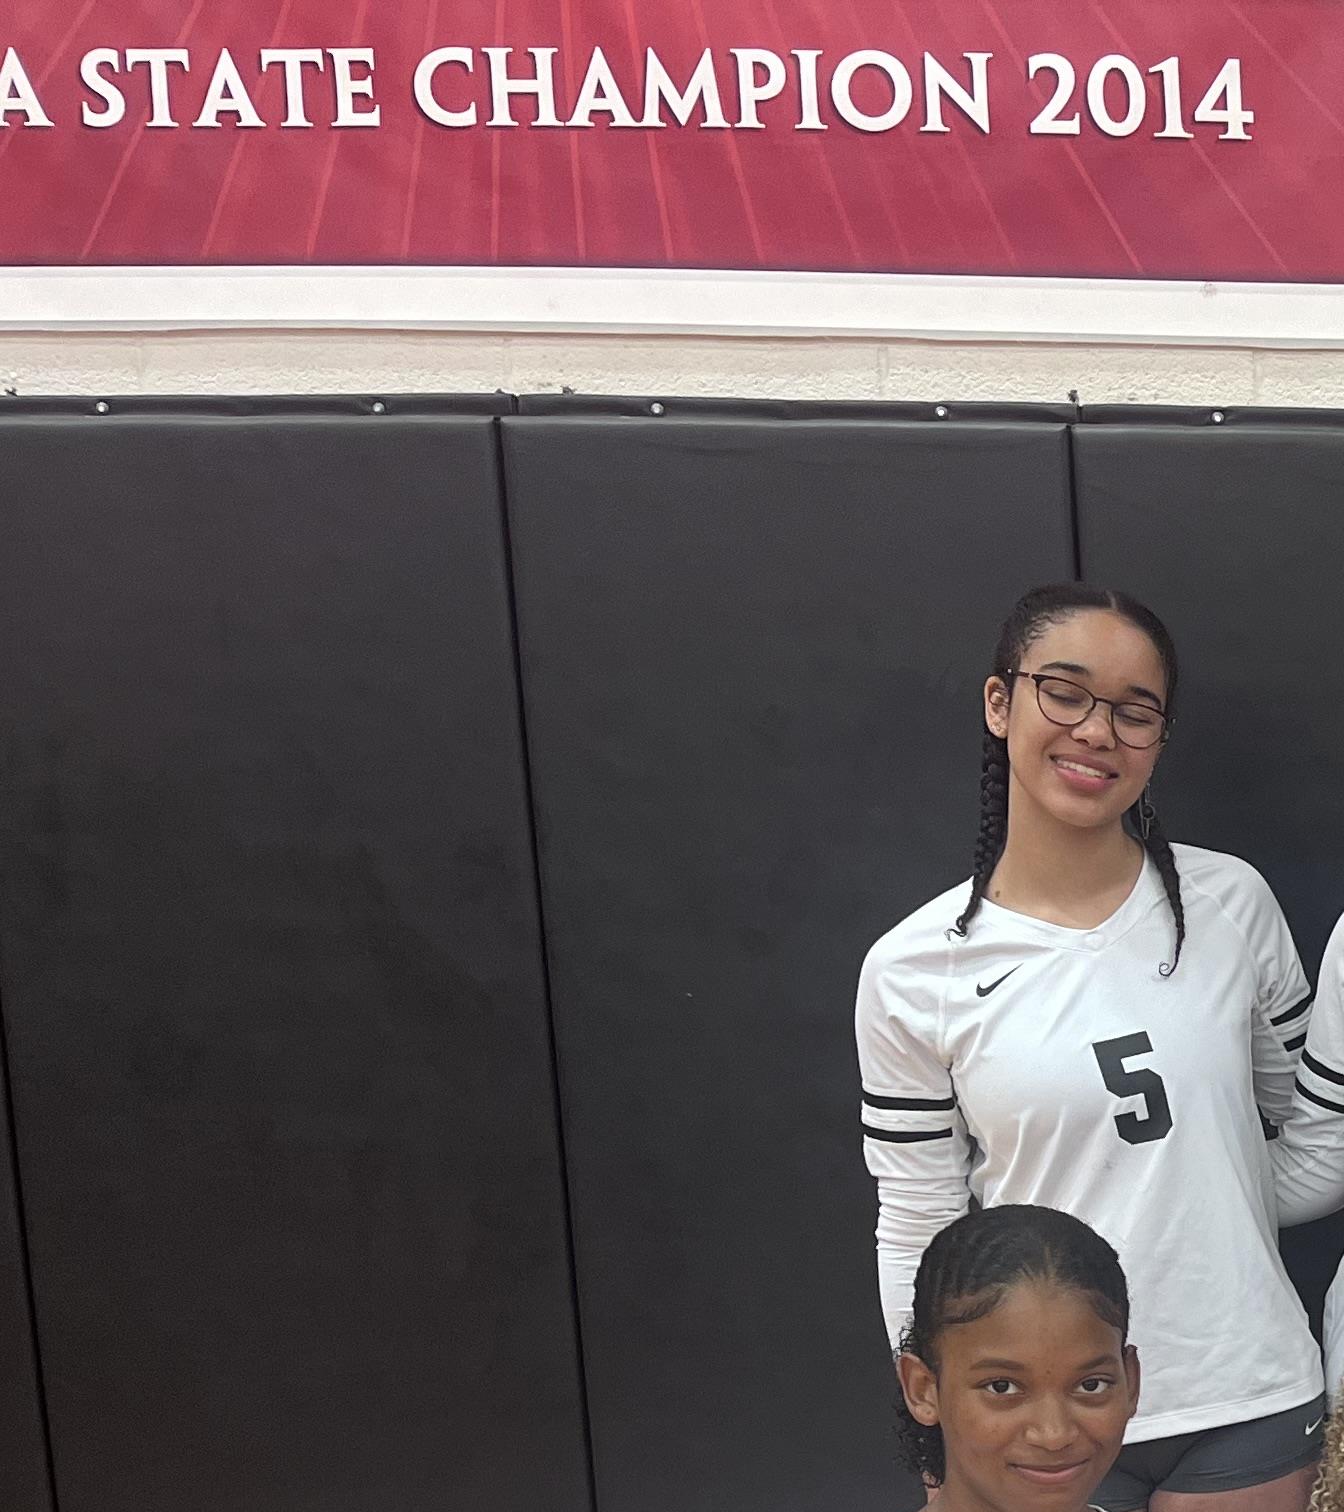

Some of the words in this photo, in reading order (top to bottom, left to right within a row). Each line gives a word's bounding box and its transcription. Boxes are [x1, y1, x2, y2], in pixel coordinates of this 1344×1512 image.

[80, 47, 381, 129] STATE
[413, 46, 992, 133] CHAMPION
[1028, 54, 1255, 141] 2014
[1091, 1030, 1174, 1145] 5
